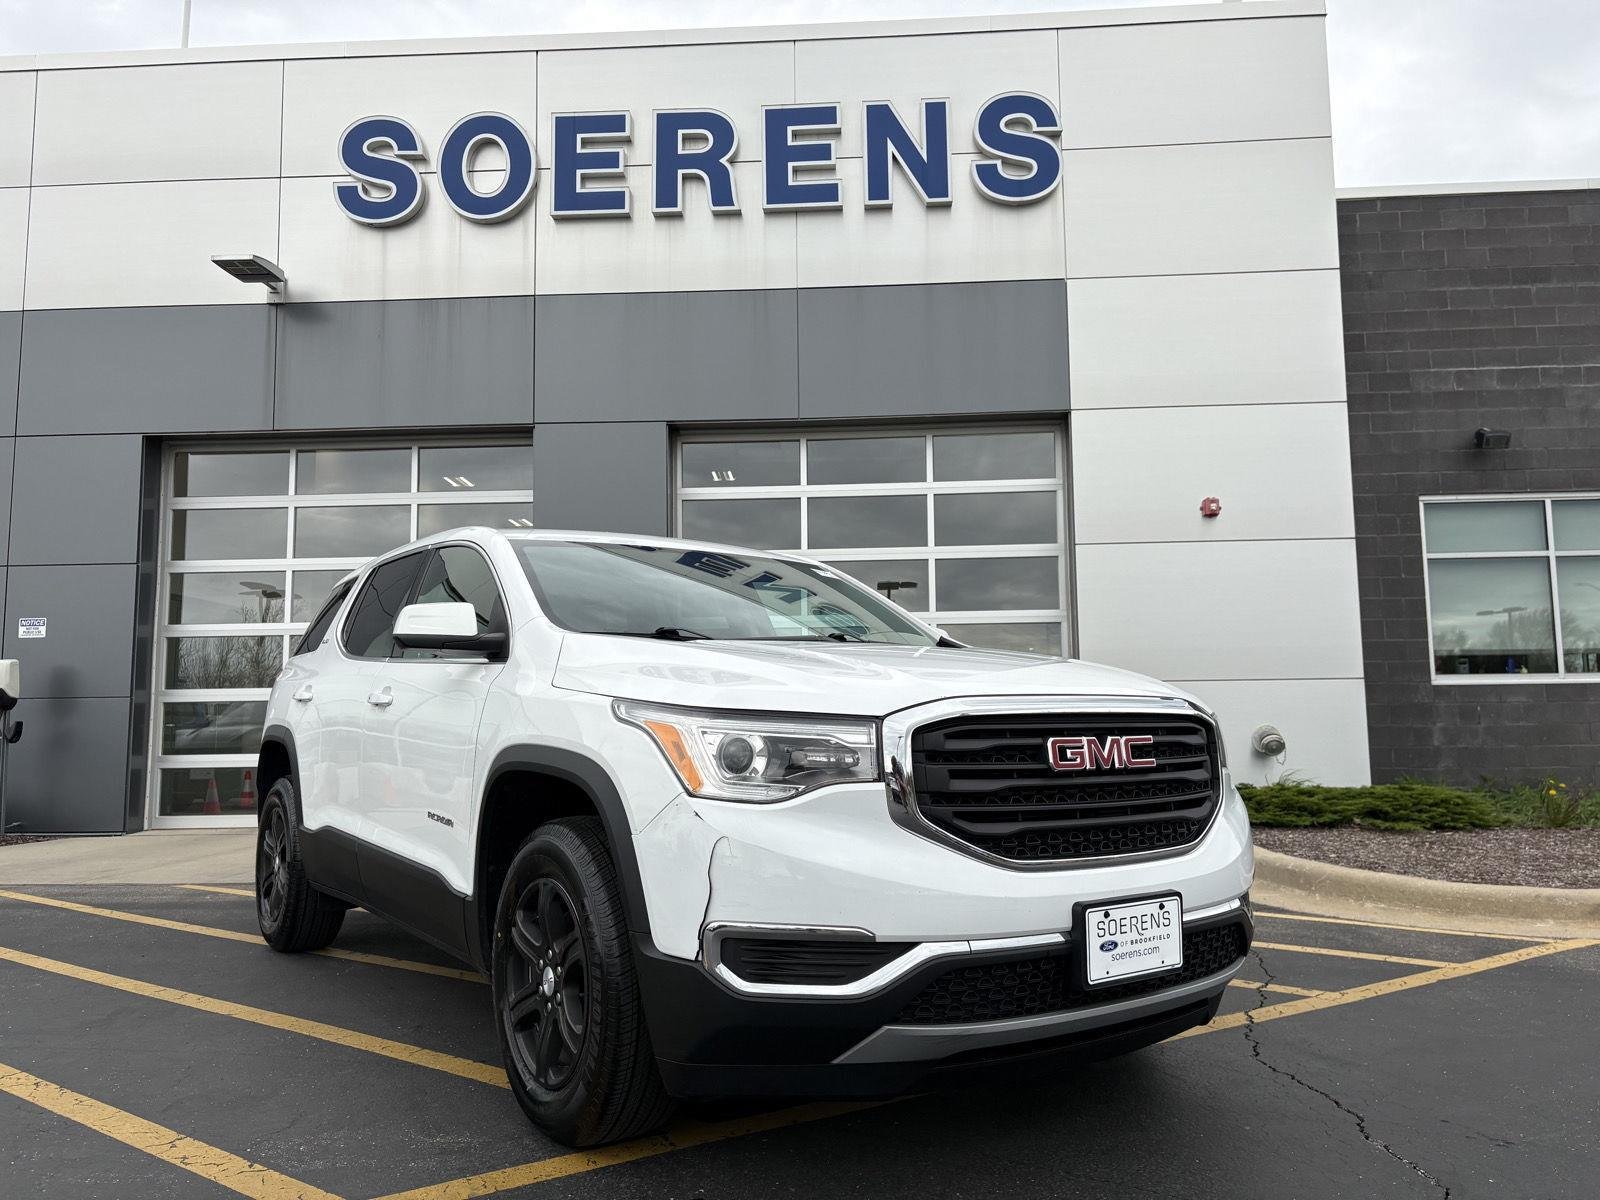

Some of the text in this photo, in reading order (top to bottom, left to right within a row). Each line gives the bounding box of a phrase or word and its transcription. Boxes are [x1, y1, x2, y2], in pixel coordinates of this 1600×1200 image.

[333, 91, 1063, 226] SOERENS
[1047, 736, 1156, 771] GMC
[1097, 911, 1171, 938] SOERENS
[1130, 933, 1171, 945] BROOKFIELD
[1111, 946, 1160, 961] soerens.com
